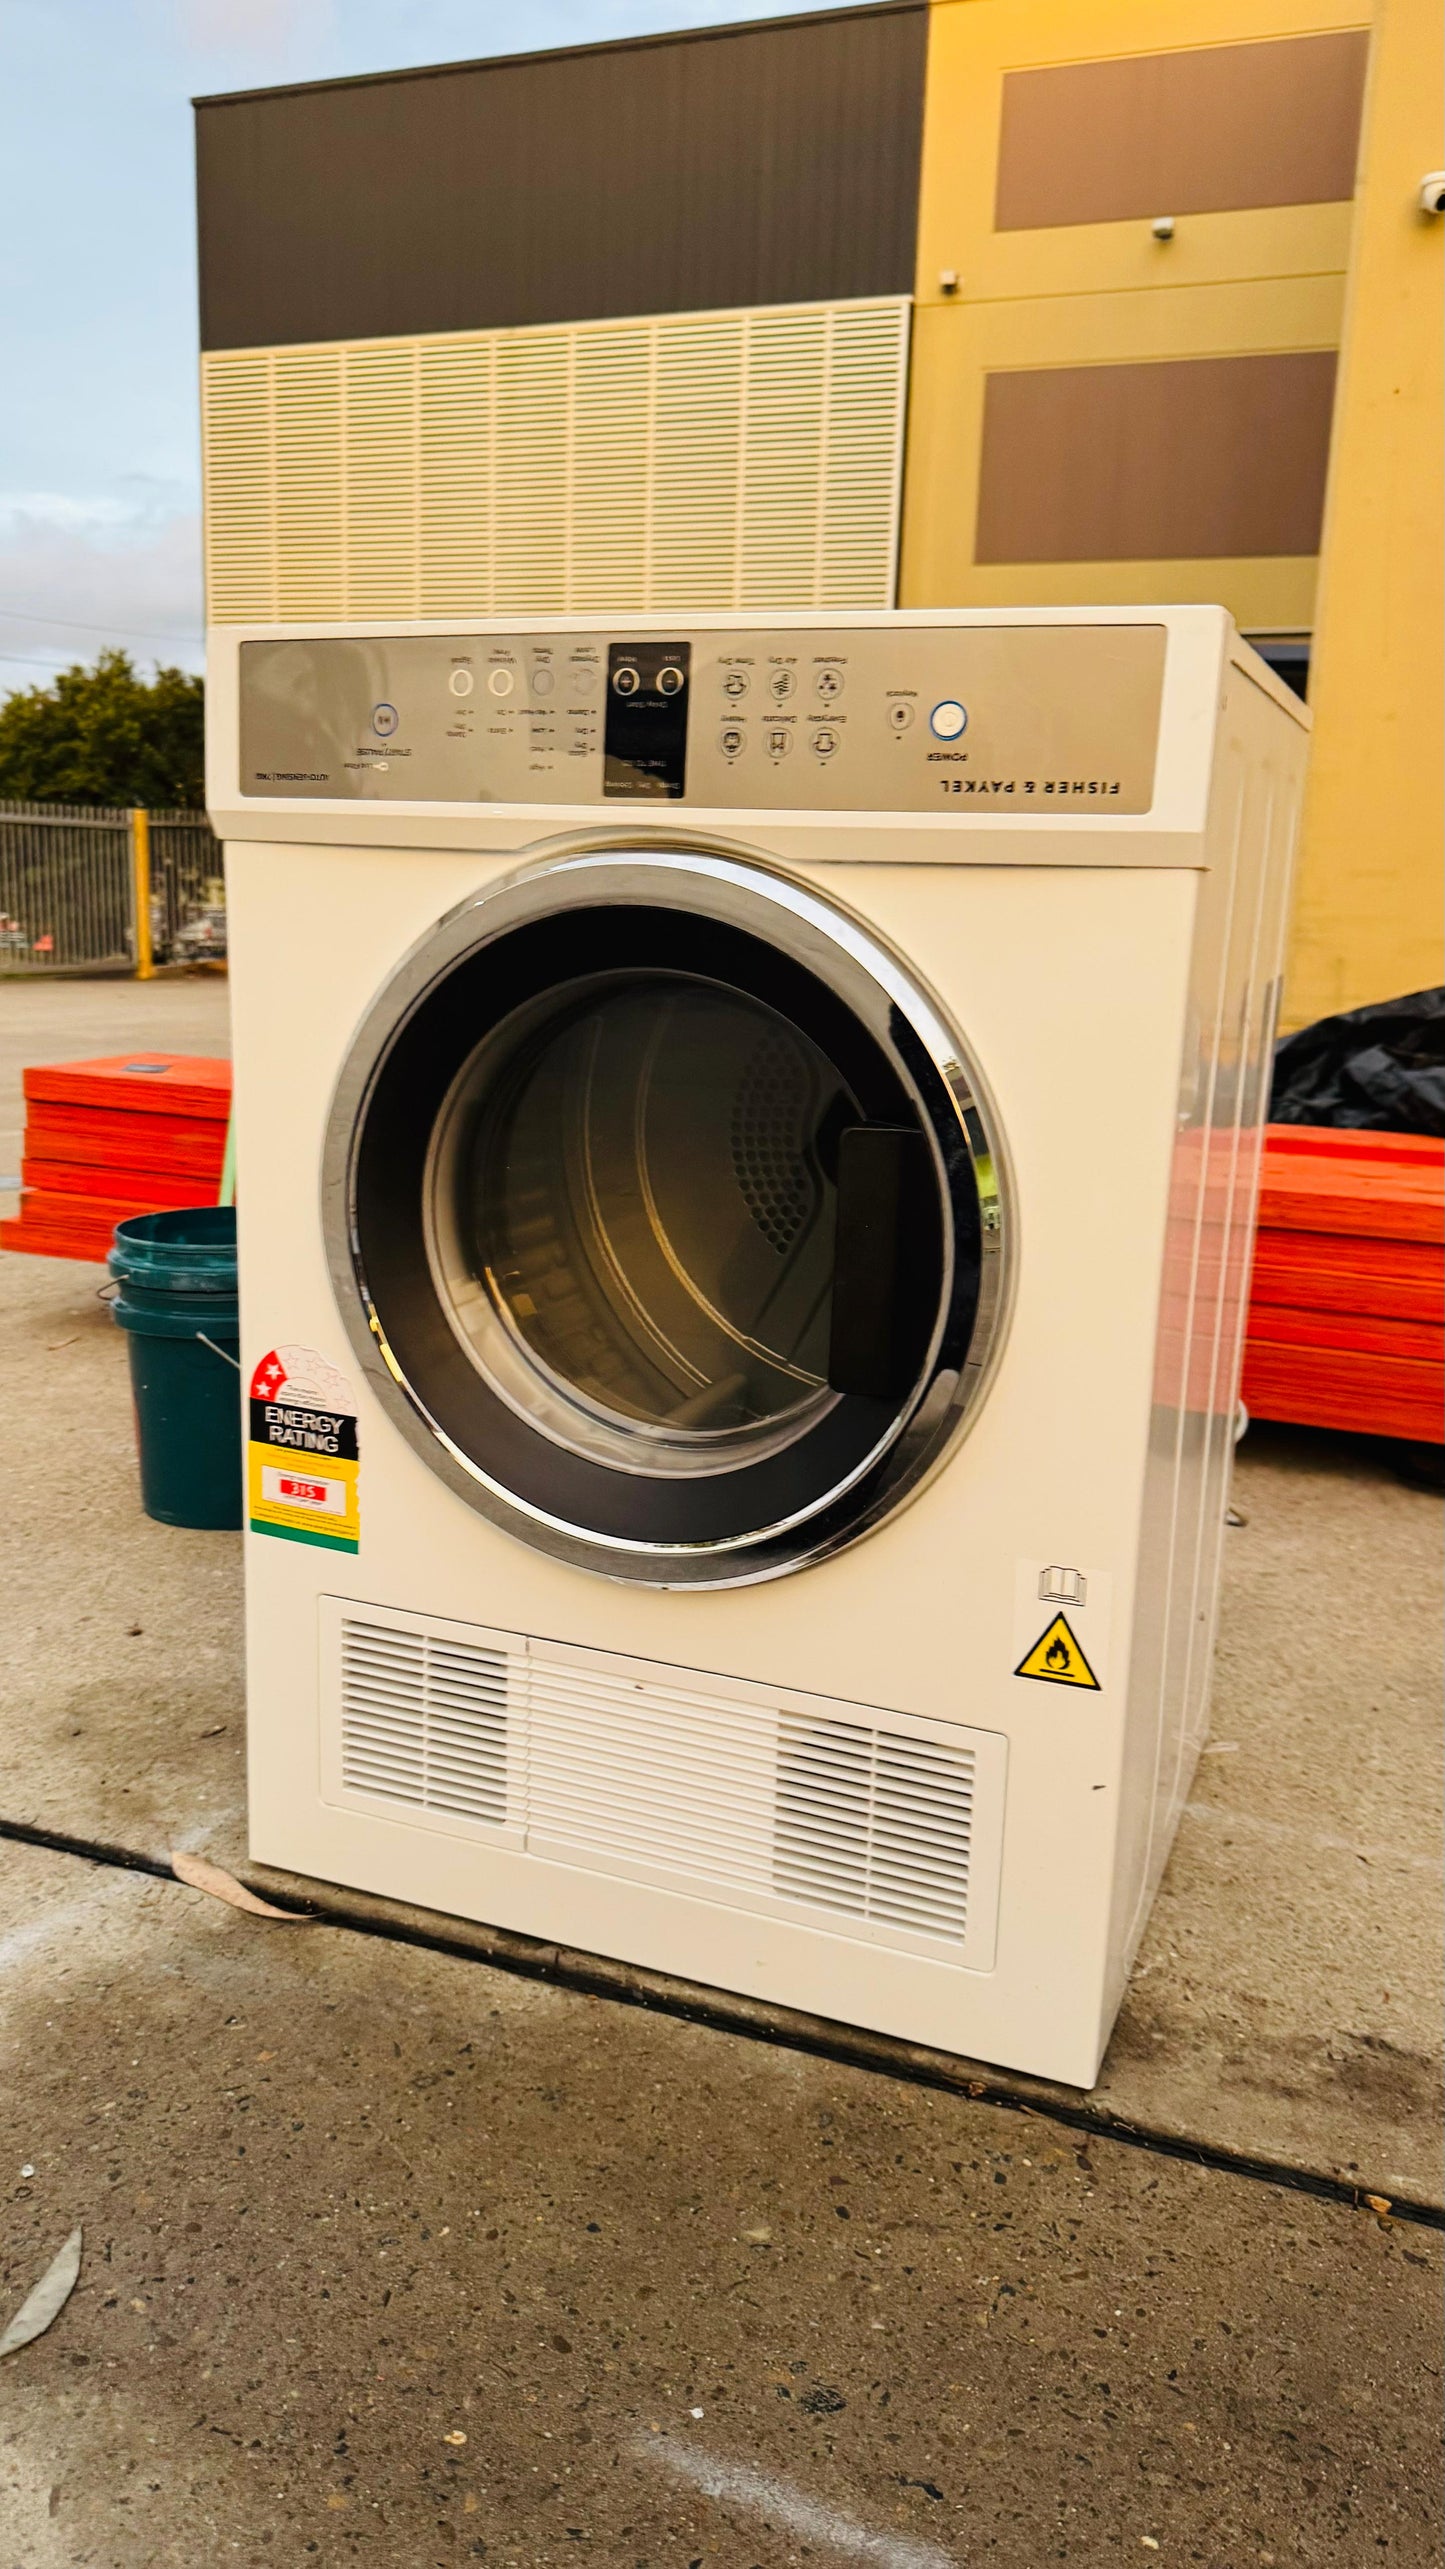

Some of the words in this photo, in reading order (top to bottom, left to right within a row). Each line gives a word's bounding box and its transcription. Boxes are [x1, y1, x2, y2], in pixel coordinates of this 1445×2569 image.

[807, 715, 847, 723] Everyday
[927, 753, 968, 761] POWER
[940, 780, 1015, 793] PAYKEL
[1024, 781, 1035, 793] &
[1044, 782, 1120, 794] FISHER
[264, 1405, 345, 1435] ENERGY
[268, 1425, 339, 1453] RATING
[290, 1482, 316, 1498] 315
